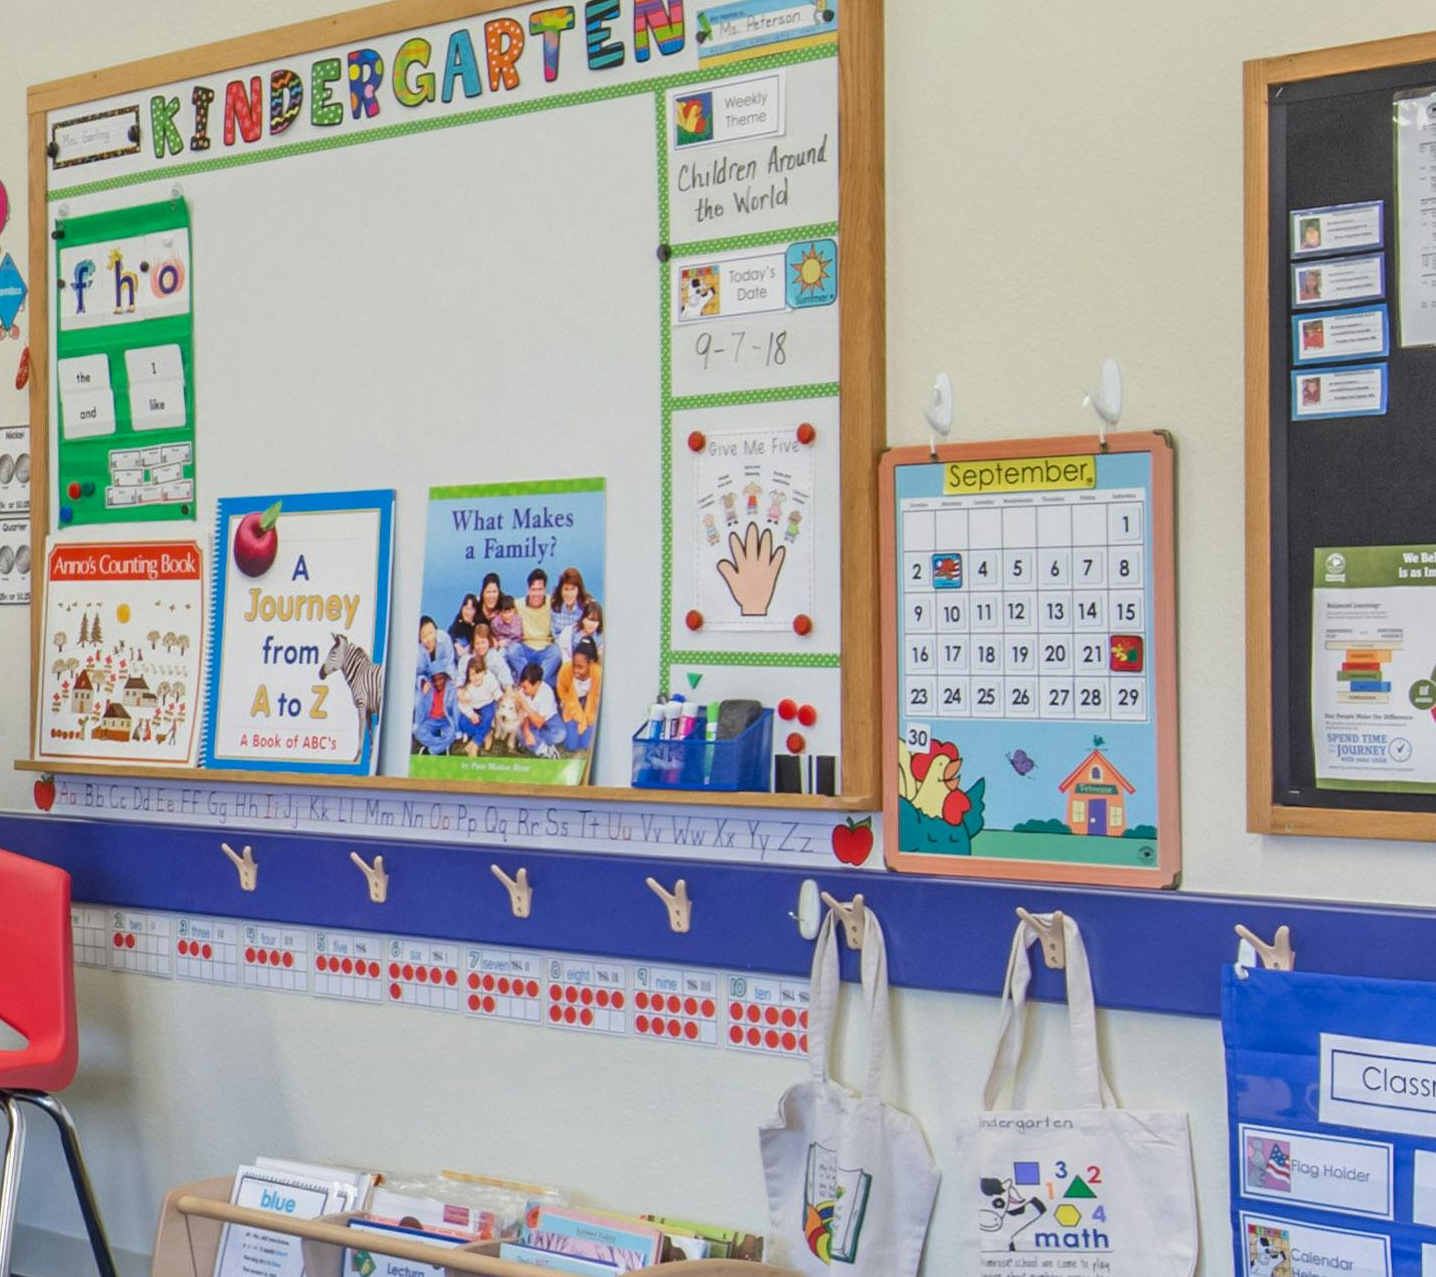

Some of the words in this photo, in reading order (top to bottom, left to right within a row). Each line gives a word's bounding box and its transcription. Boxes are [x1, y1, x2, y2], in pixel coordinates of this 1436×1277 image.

[746, 11, 801, 32] Peterson
[725, 91, 768, 110] Weekly
[725, 111, 767, 128] Theme
[678, 156, 757, 192] Children
[768, 134, 827, 172] Around
[695, 198, 724, 222] the
[733, 177, 788, 214] World
[73, 260, 94, 314] f
[114, 258, 137, 313] h
[729, 266, 776, 286] Today's
[737, 287, 768, 301] Date
[77, 373, 91, 384] the
[80, 407, 97, 420] and
[149, 399, 165, 411] like
[5, 431, 26, 441] Nickel
[709, 441, 737, 457] Give
[744, 439, 765, 455] Me
[772, 436, 800, 453] Five
[949, 460, 1088, 491] September
[2, 522, 28, 532] Quarter
[451, 509, 504, 532] What
[511, 507, 574, 529] Makes
[1123, 516, 1130, 533] 1
[465, 546, 475, 560] a
[483, 535, 557, 565] Family?
[54, 554, 95, 574] Anno's
[99, 553, 158, 580] Counting
[161, 550, 196, 573] Book
[291, 555, 310, 581] A
[912, 564, 922, 580] 2
[978, 561, 988, 578] 4
[1013, 560, 1023, 577] 5
[1050, 560, 1060, 577] 6
[1083, 560, 1093, 576] 7
[1119, 560, 1129, 577] 8
[244, 587, 361, 630] Journey
[914, 606, 923, 622] 9
[944, 606, 960, 623] 10
[977, 604, 991, 621] 11
[1007, 603, 1025, 620] 12
[1046, 603, 1064, 620] 13
[1078, 602, 1097, 619] 14
[1117, 603, 1135, 621] 15
[263, 635, 319, 665] from
[912, 646, 929, 663] 16
[944, 645, 961, 662] 17
[978, 646, 995, 664] 18
[1012, 646, 1029, 663] 19
[1045, 645, 1066, 662] 20
[1083, 645, 1102, 664] 21
[250, 684, 271, 719] A
[277, 693, 302, 717] to
[309, 685, 330, 720] Z
[910, 688, 928, 705] 23
[943, 688, 962, 705] 24
[977, 688, 995, 705] 25
[1011, 688, 1030, 706] 26
[1049, 689, 1070, 706] 27
[1080, 689, 1102, 706] 28
[1118, 689, 1139, 706] 29
[239, 734, 249, 746] A
[252, 734, 281, 748] Book
[286, 735, 299, 749] of
[303, 736, 337, 751] ABC's
[908, 729, 928, 747] 30
[1337, 744, 1387, 757] JOURNEY
[1055, 1161, 1067, 1179] 3
[1086, 1166, 1102, 1184] 2
[1290, 1159, 1319, 1178] Flag
[1324, 1163, 1370, 1183] Holder
[261, 1189, 296, 1213] blue
[1045, 1182, 1054, 1200] 1
[1092, 1205, 1106, 1223] 4
[1035, 1228, 1109, 1248] math
[1291, 1248, 1354, 1271] Calendar
